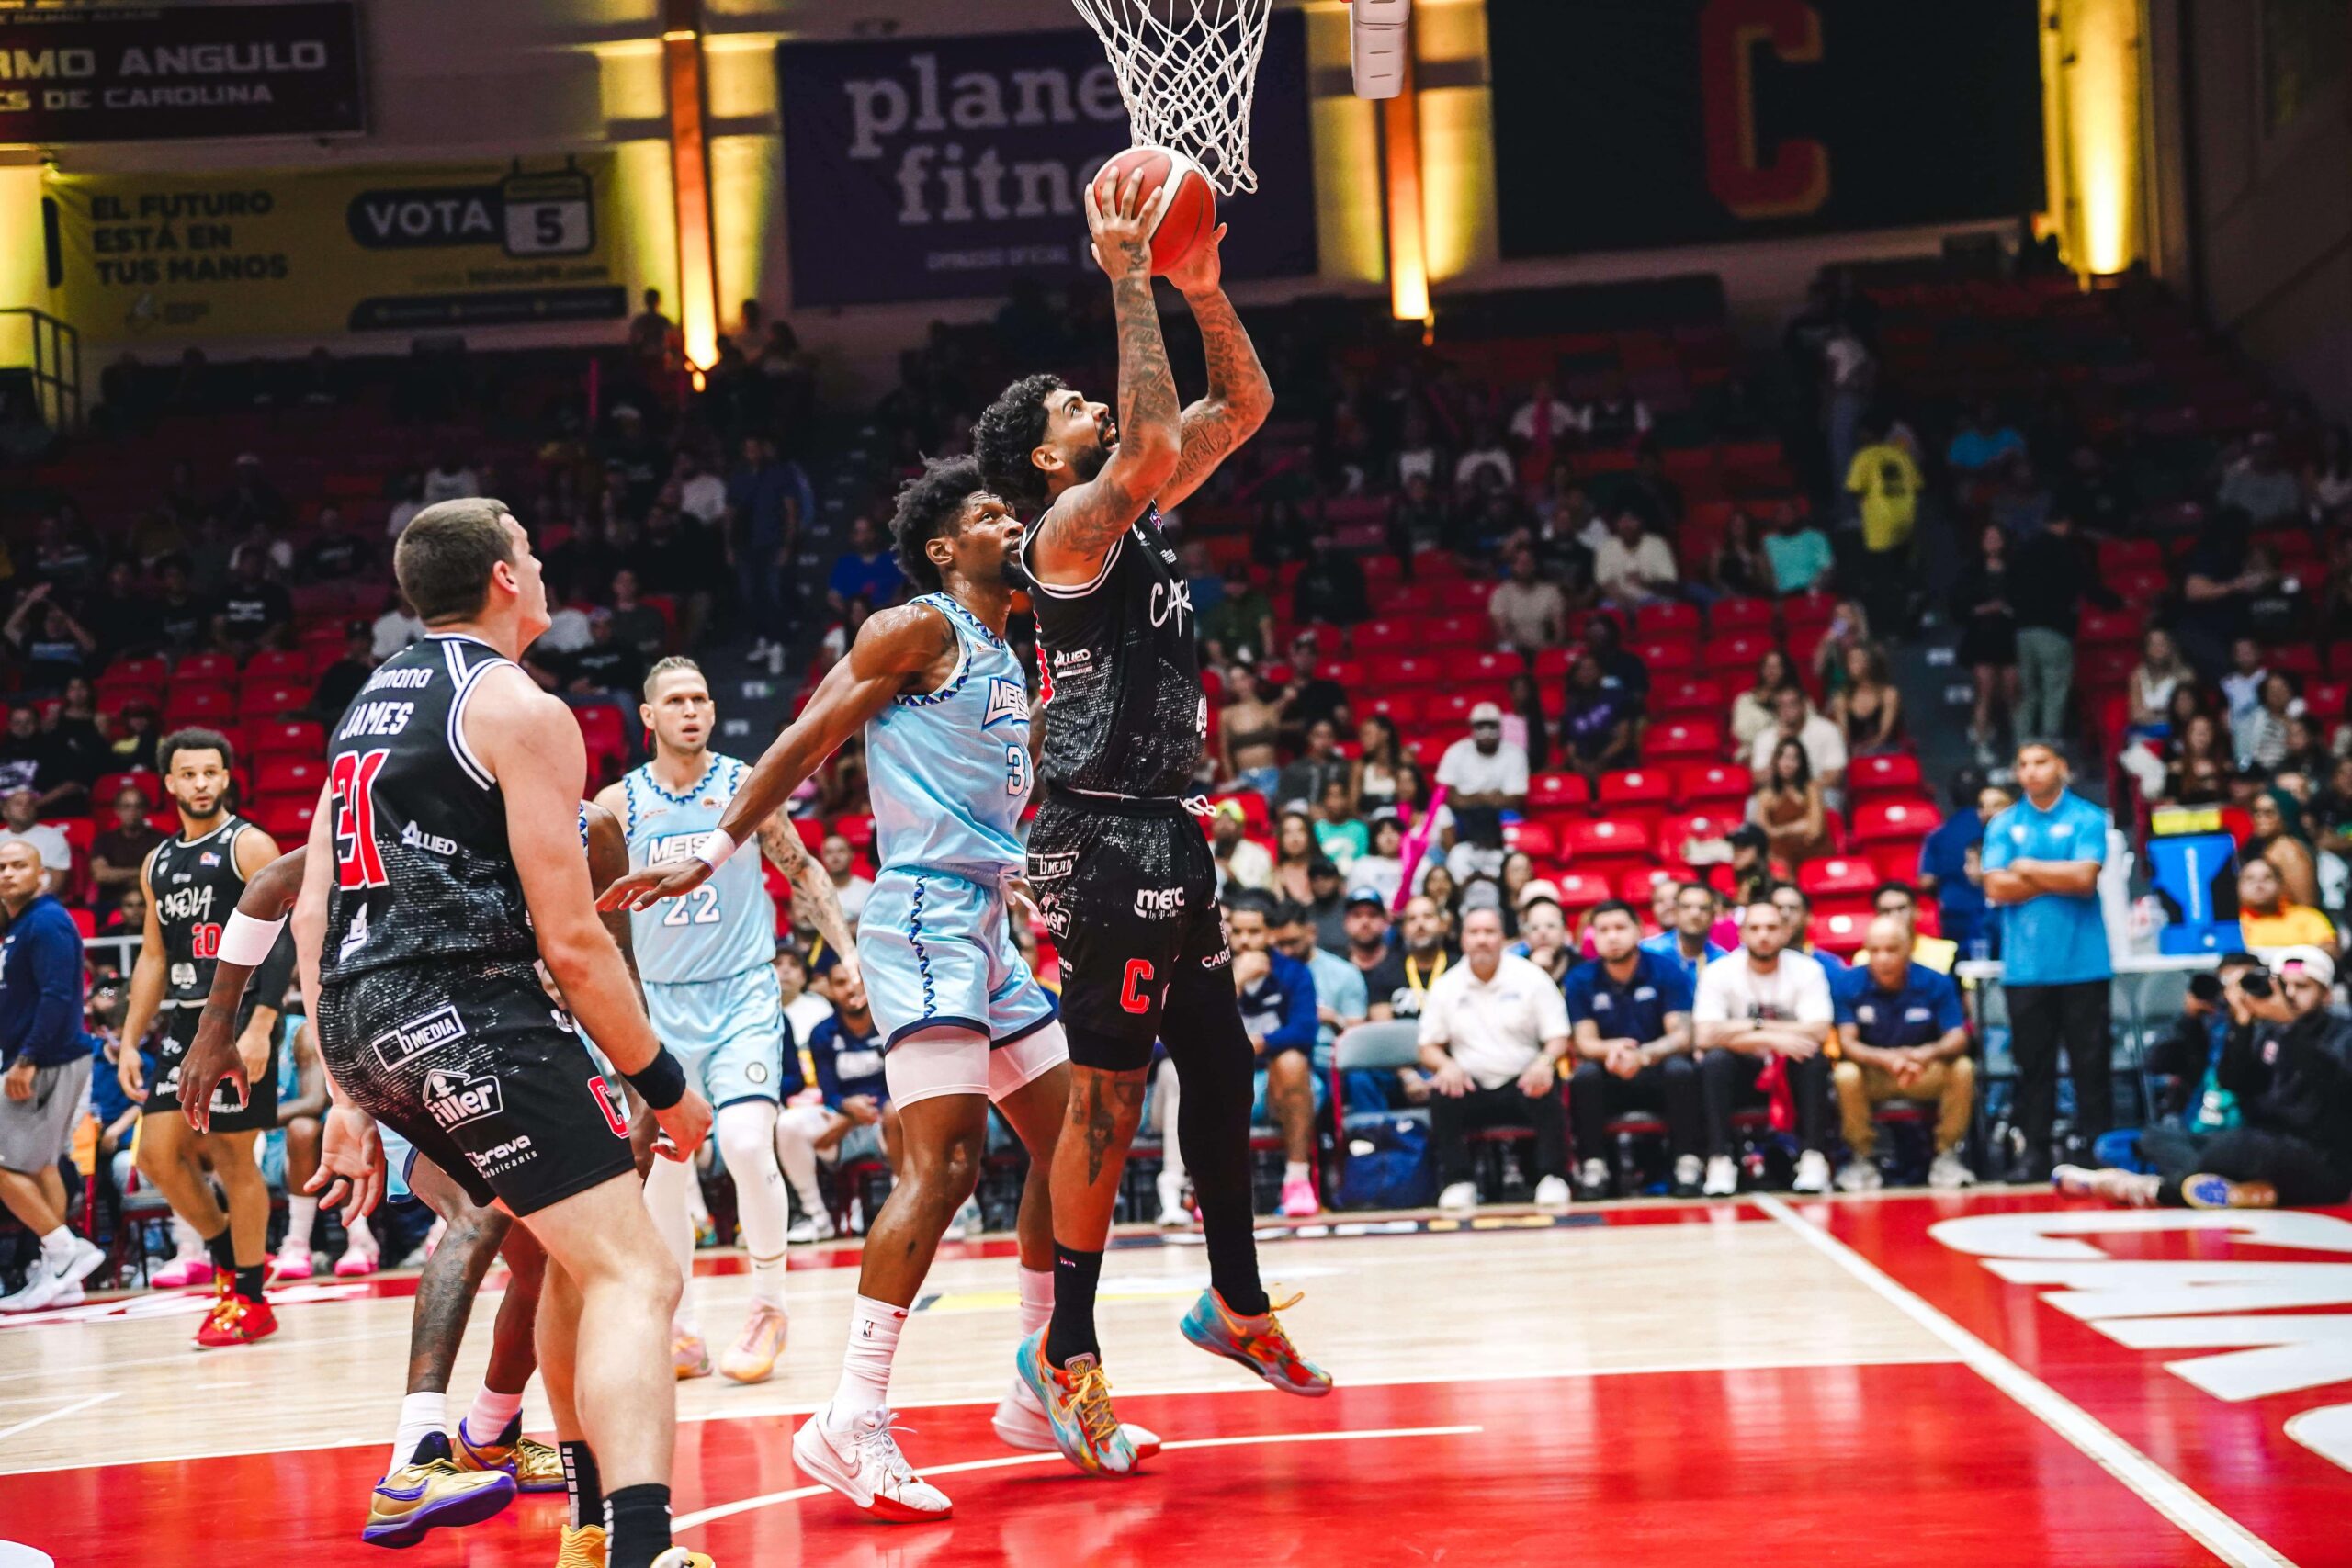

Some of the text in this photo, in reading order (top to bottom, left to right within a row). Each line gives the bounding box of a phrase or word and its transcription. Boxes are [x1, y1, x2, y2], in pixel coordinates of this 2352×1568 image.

[119, 41, 327, 76] ANGULO
[45, 90, 91, 110] DE
[104, 85, 273, 109] CAROLINA
[844, 52, 1169, 158] plane
[1701, 0, 1829, 220] C
[92, 190, 274, 220] EL FUTURO
[366, 197, 493, 236] VOTA
[94, 219, 232, 253] ESTÁ EN
[534, 205, 564, 248] 5
[96, 254, 288, 286] TUS MANOS
[339, 701, 414, 740] JAMES
[331, 748, 391, 891] 31
[401, 819, 458, 856] ALLIED
[662, 883, 720, 927] 22
[192, 922, 222, 959] 20
[1120, 958, 1154, 1014] C
